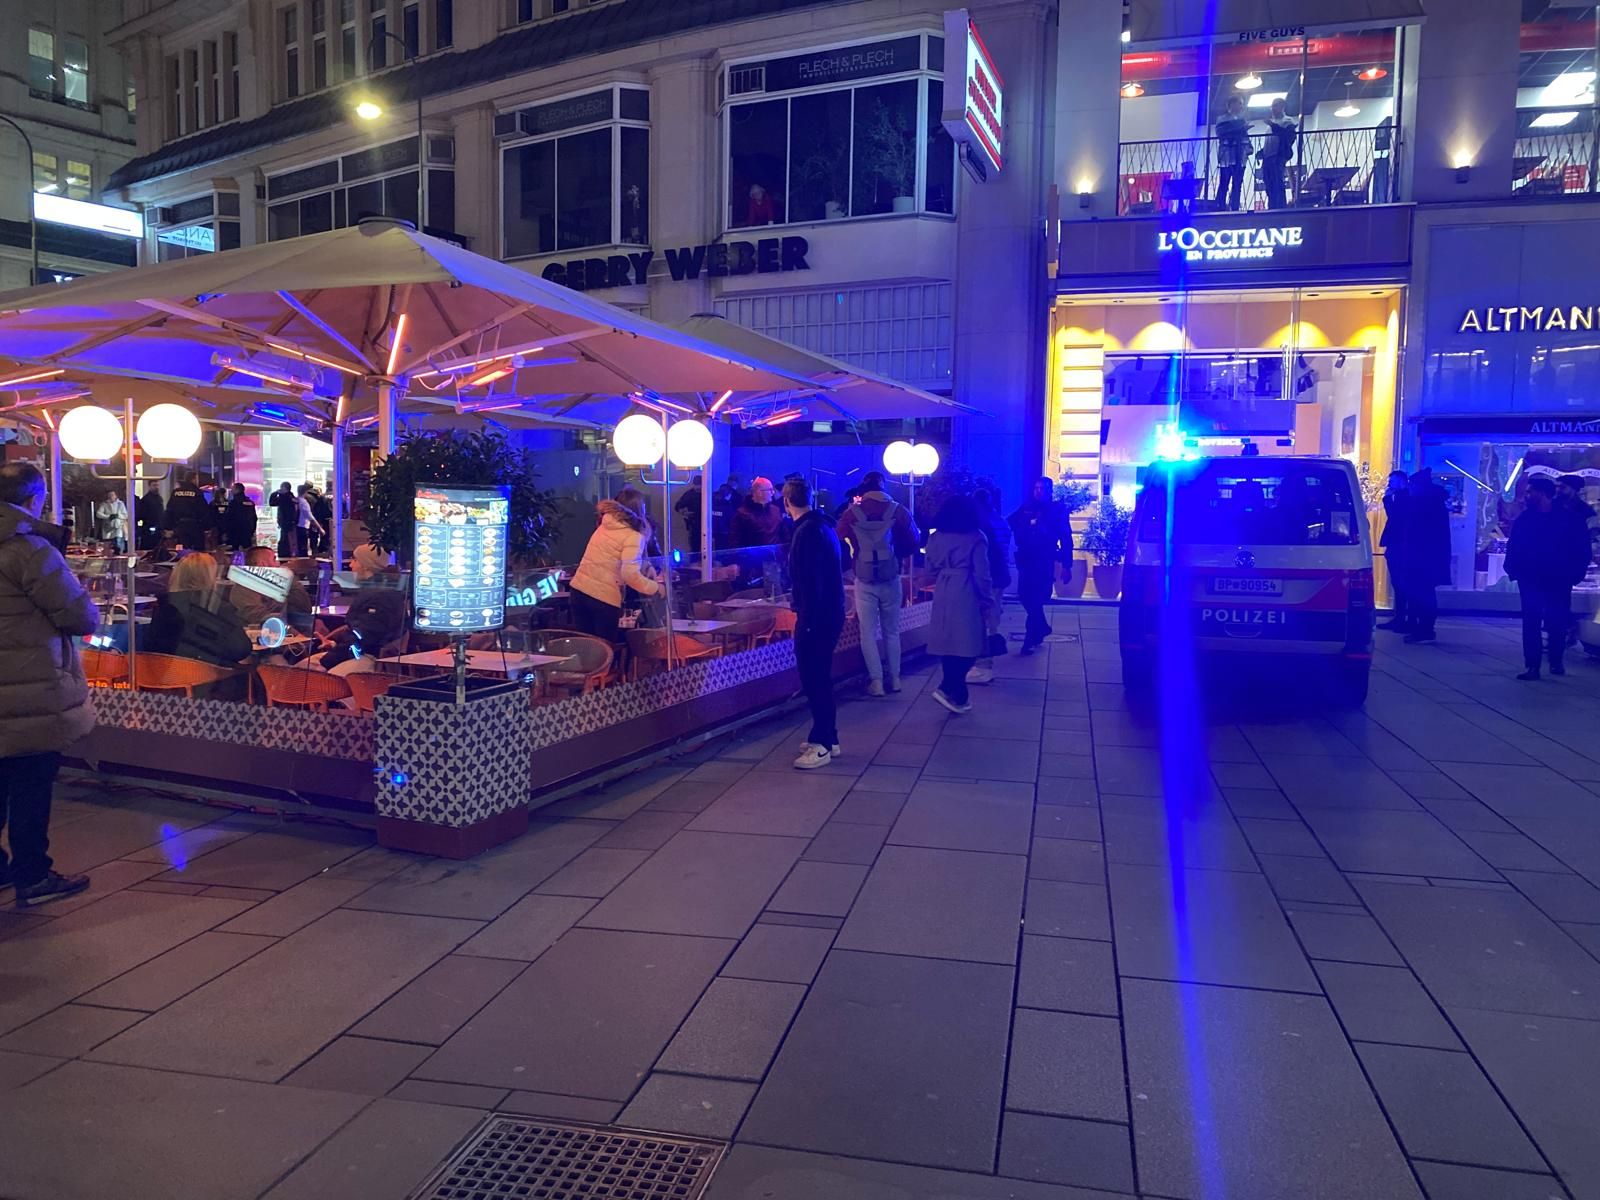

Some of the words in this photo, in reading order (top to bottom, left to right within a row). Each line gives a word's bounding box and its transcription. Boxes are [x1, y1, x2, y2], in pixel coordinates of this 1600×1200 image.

[1240, 30, 1267, 41] FIVE
[1271, 26, 1305, 38] GUYS
[799, 57, 839, 74] PLECH
[841, 56, 848, 67] &
[852, 48, 894, 65] PLECH
[541, 250, 654, 291] GERRY
[664, 236, 810, 281] WEBER
[1207, 247, 1274, 260] PROVENCE
[1459, 306, 1600, 332] ALTMAN
[1202, 608, 1286, 624] POLIZEI
